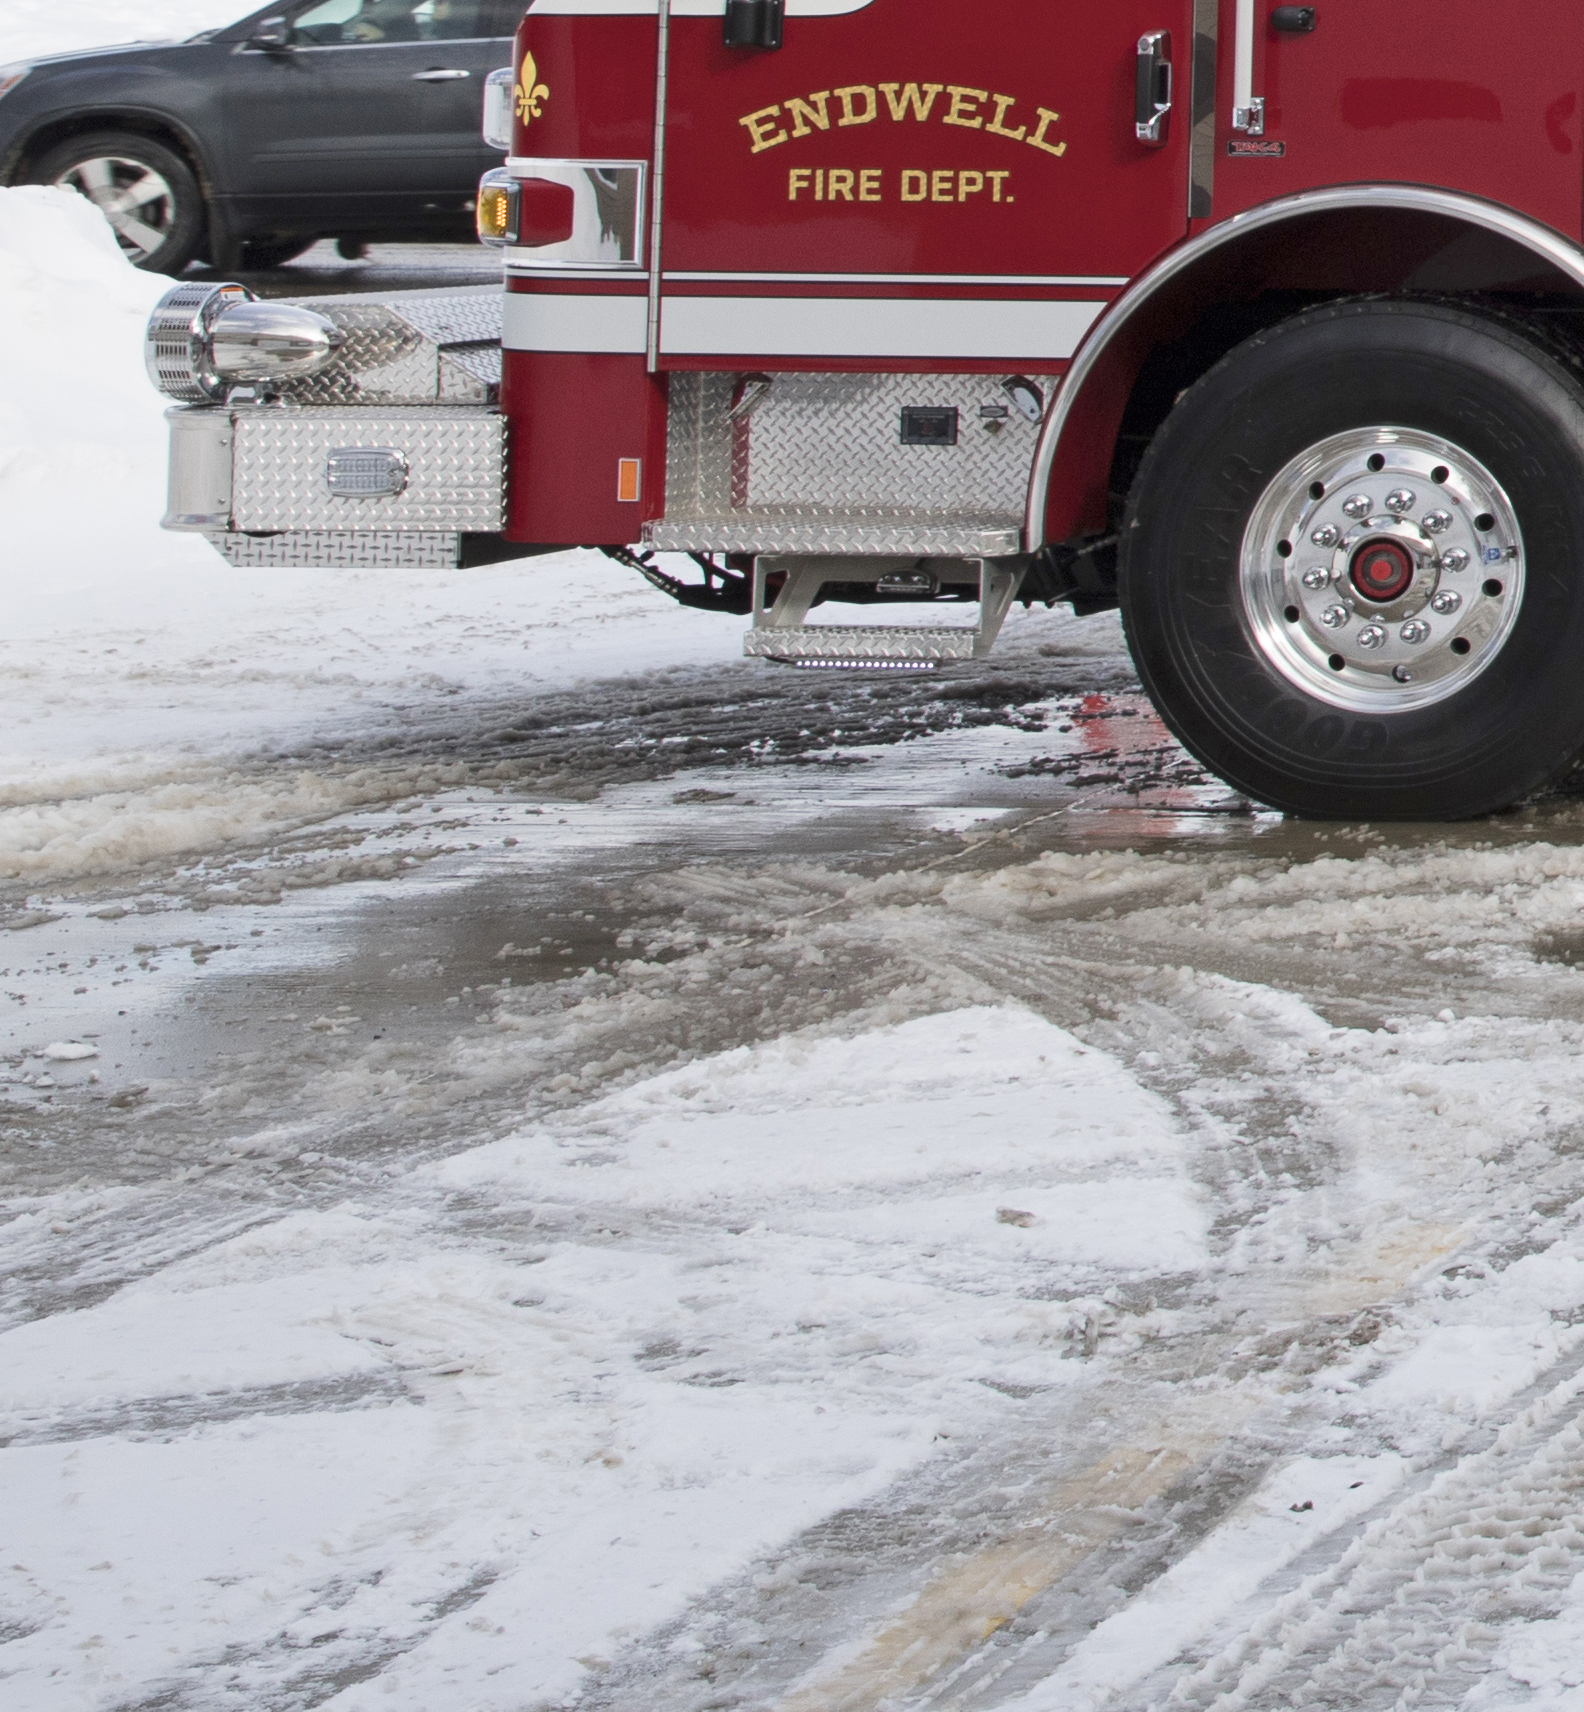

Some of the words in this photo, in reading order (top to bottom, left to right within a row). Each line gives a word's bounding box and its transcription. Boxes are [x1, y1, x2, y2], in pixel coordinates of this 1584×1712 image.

[738, 81, 1068, 159] ENDWELL
[787, 168, 883, 202] FIRE
[899, 168, 1015, 203] DEPT.
